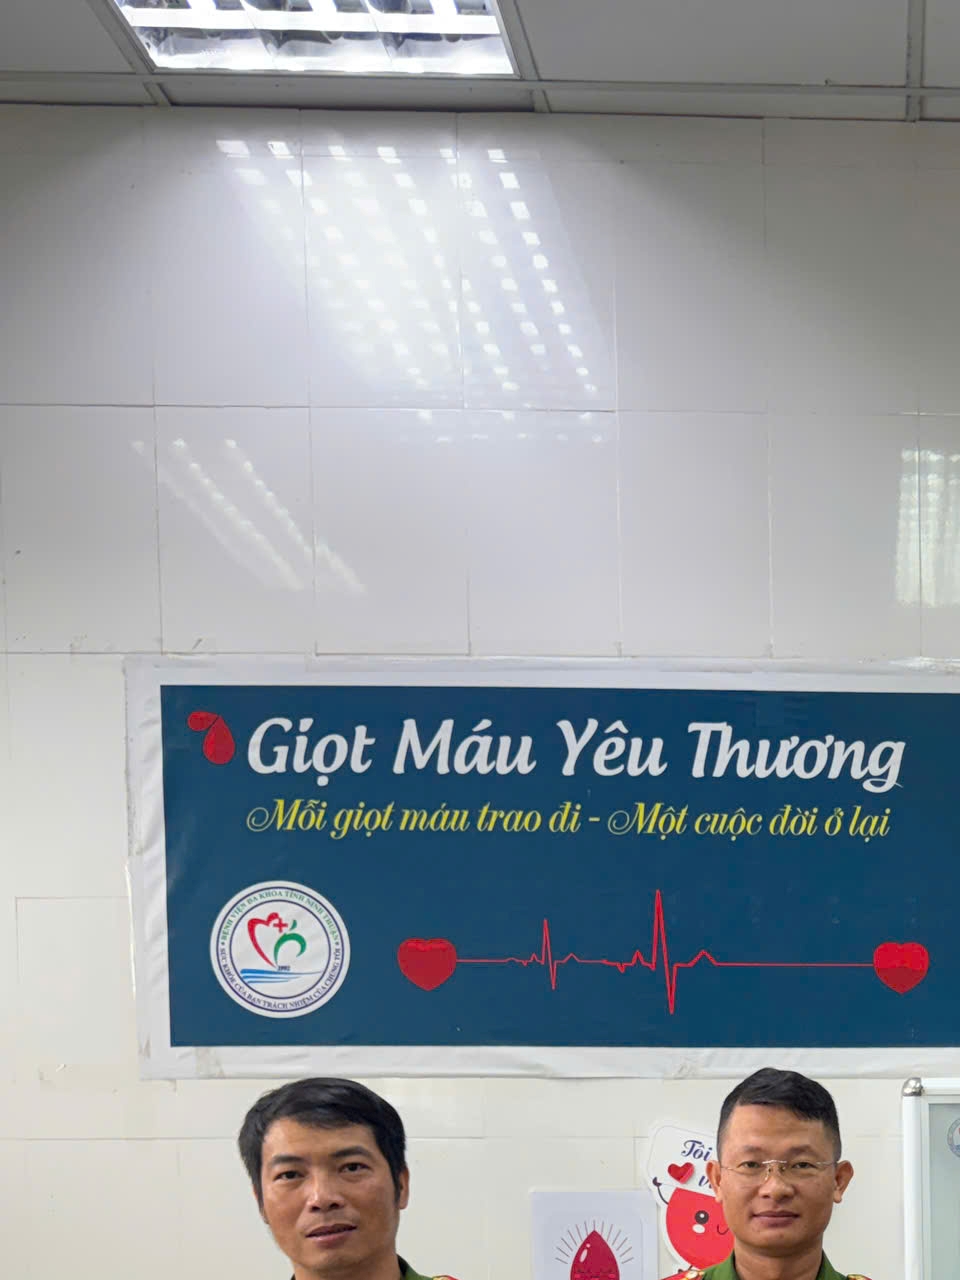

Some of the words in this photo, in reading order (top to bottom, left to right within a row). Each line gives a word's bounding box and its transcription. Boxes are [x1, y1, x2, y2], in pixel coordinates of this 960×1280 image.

[248, 717, 376, 786] Giọt
[392, 718, 536, 775] Máu
[556, 718, 668, 776] Yêu
[688, 721, 906, 794] Thương
[246, 798, 328, 832] Mỗi
[330, 801, 395, 840] giọt
[400, 802, 470, 832] máu
[476, 801, 542, 832] trao
[549, 801, 582, 834] đi
[608, 802, 688, 841] Một
[694, 808, 762, 842] cuộc
[769, 804, 818, 836] đời
[824, 808, 844, 836] ở
[849, 806, 891, 842] lại
[259, 890, 283, 900] KHOA
[285, 890, 304, 902] TỈNH
[306, 898, 324, 916] NINH
[262, 998, 288, 1010] TRÁCH
[289, 995, 314, 1009] NHIỆM
[681, 1140, 712, 1162] Tôi
